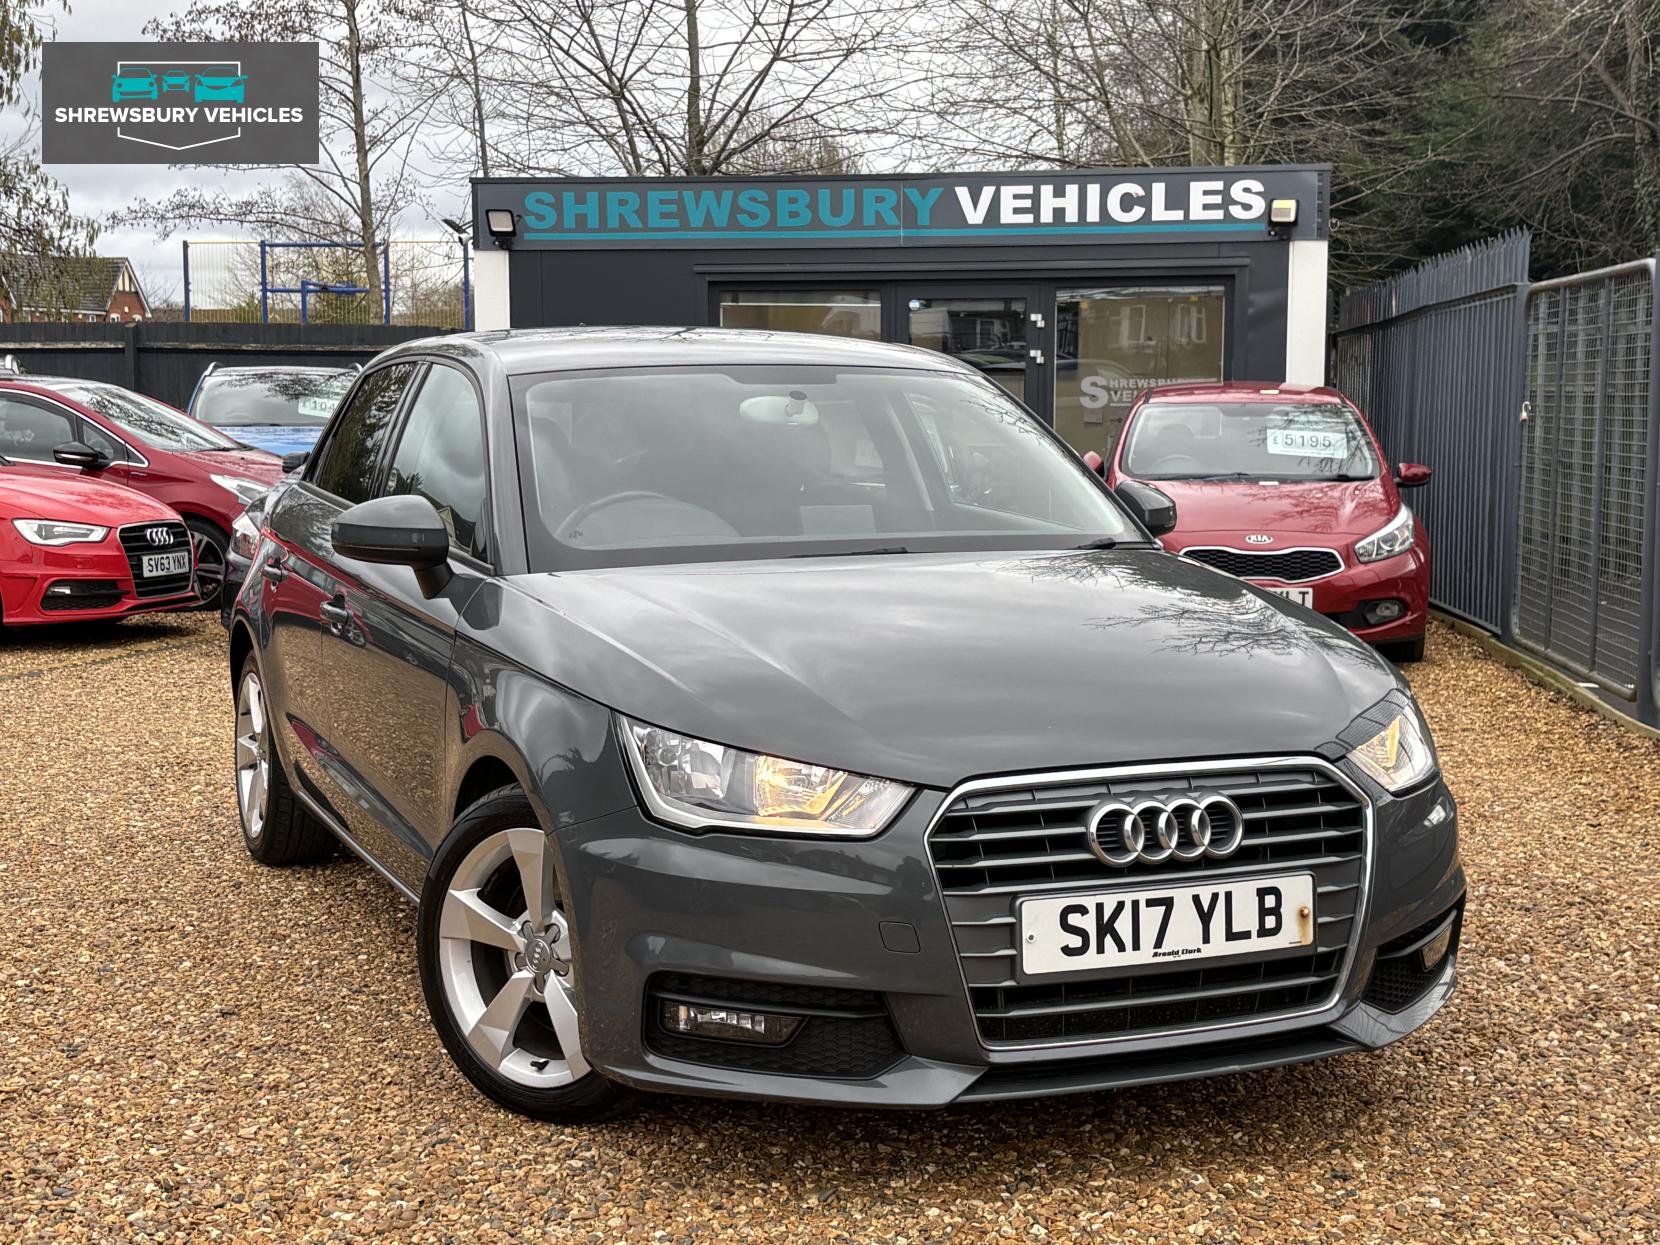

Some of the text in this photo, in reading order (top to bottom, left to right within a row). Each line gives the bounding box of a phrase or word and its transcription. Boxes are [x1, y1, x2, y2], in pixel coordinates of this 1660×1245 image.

[523, 179, 1266, 229] SHREWSBURY VEHICLES
[1248, 534, 1270, 543] KIA
[147, 554, 186, 573] SV63 YNX
[1059, 886, 1283, 957] SK17 YLB
